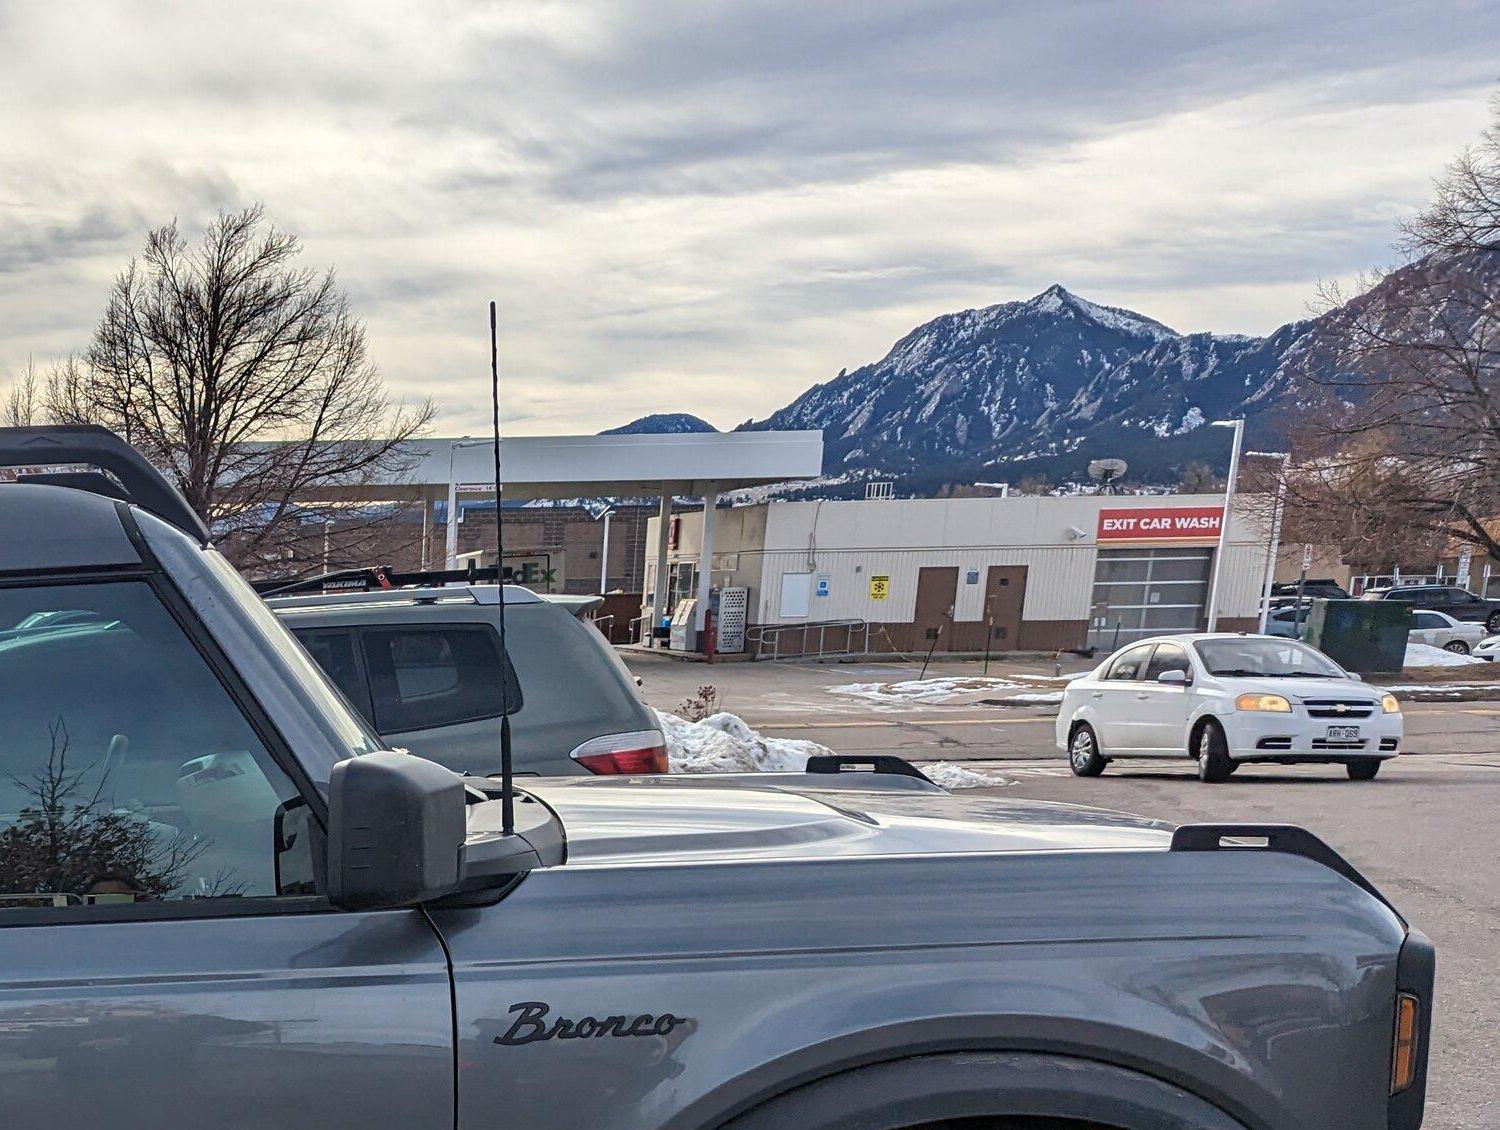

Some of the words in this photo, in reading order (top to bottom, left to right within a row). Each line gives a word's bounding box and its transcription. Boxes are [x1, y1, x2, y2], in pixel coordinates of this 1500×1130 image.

[1103, 519, 1137, 530] EXIT
[1140, 518, 1171, 530] CAR
[1175, 517, 1220, 529] WASH
[493, 1002, 686, 1045] Bronco
